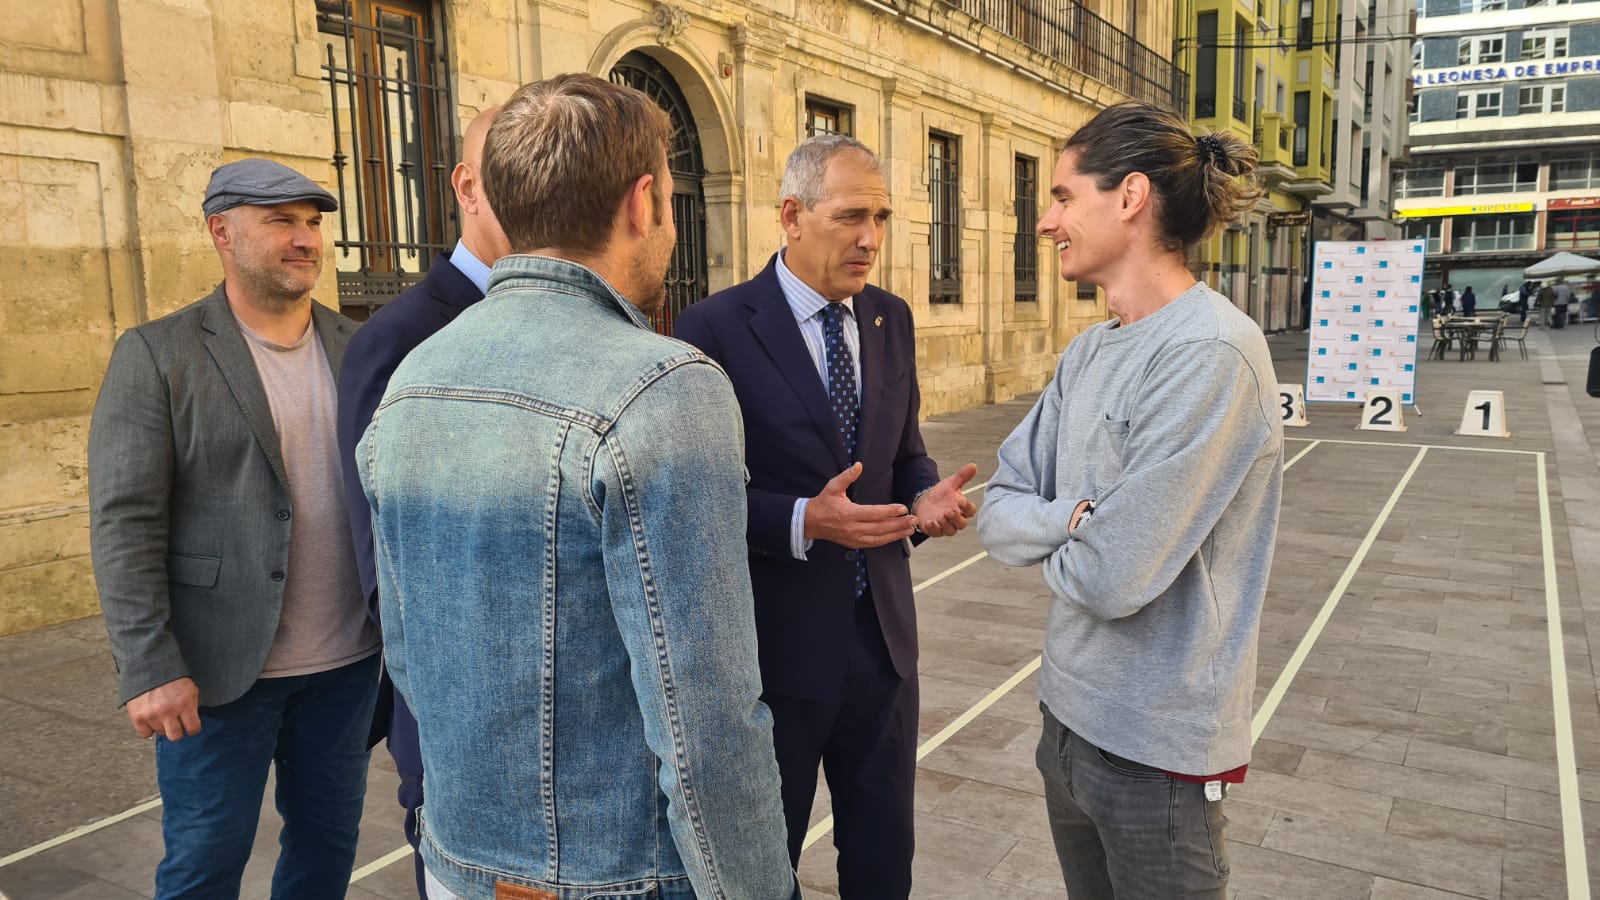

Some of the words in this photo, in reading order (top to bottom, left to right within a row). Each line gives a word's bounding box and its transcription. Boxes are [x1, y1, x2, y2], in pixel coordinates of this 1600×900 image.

[1428, 68, 1507, 84] LEONESA
[1515, 65, 1537, 77] DE
[1280, 392, 1294, 421] 3
[1369, 396, 1393, 425] 2
[1475, 401, 1491, 430] 1
